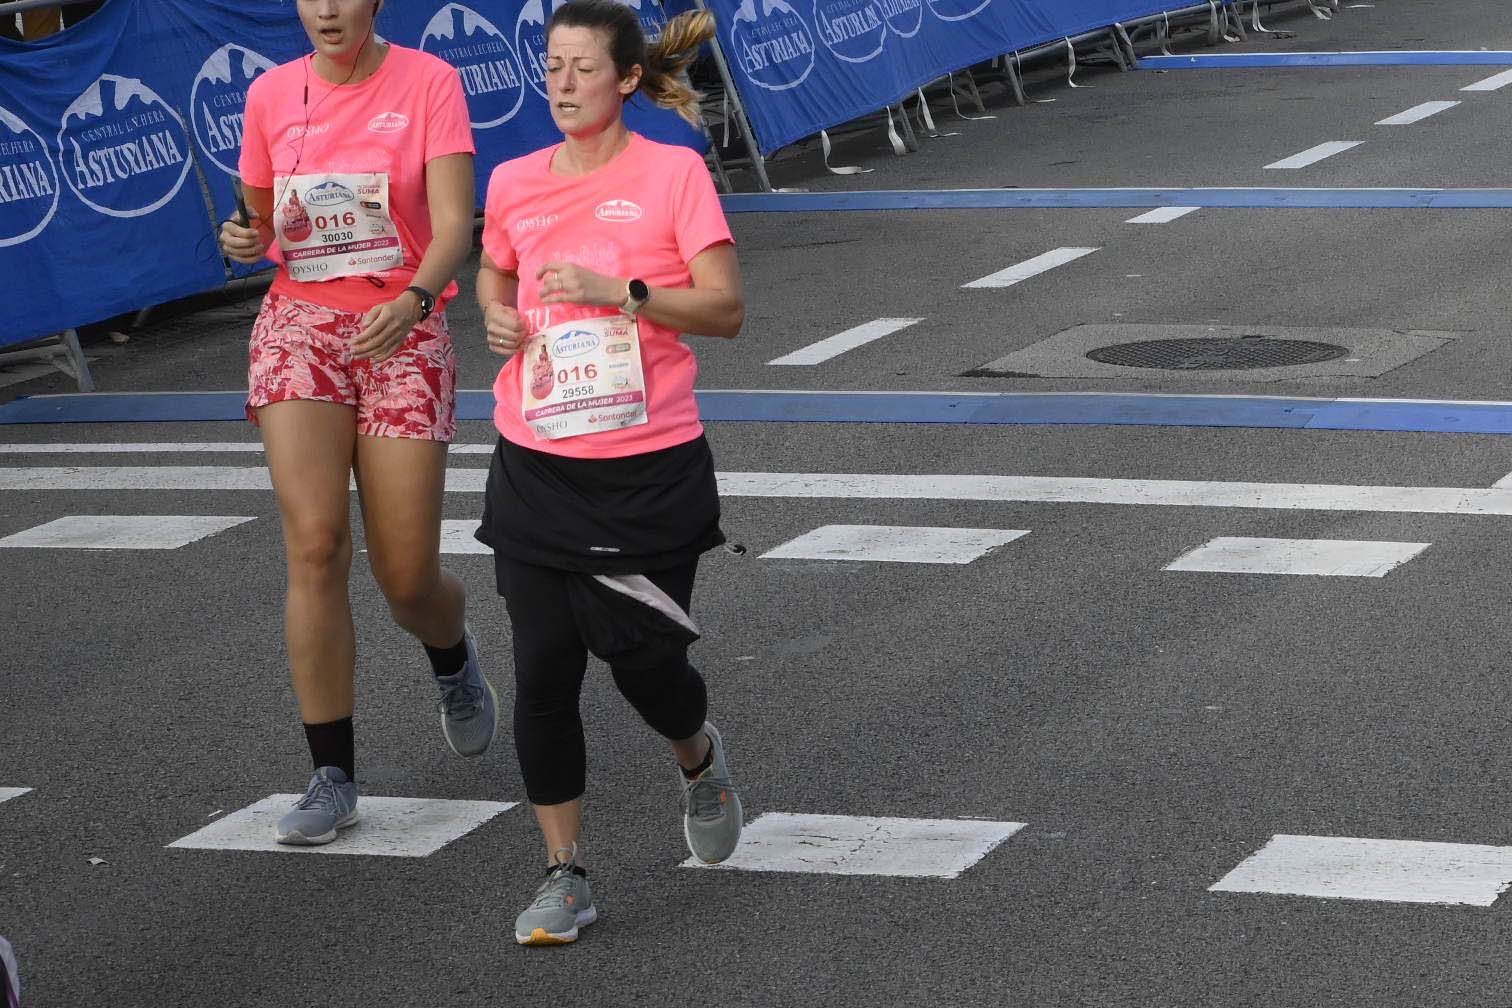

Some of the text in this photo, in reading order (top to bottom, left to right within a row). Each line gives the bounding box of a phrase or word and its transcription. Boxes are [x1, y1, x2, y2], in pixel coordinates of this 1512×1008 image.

[81, 123, 125, 143] CENTRAL
[70, 130, 183, 190] ASTURIANA
[0, 160, 53, 203] RIANA
[315, 212, 356, 230] 016
[321, 231, 353, 243] 30030
[293, 248, 325, 258] CARRERA
[326, 246, 336, 255] DE
[348, 242, 371, 251] MUJER
[374, 239, 389, 247] 2023
[358, 254, 395, 265] Santander
[292, 263, 328, 275] OYSHO
[557, 363, 598, 384] 016
[562, 385, 595, 399] 29558
[535, 395, 633, 417] CARRERA DE LA MUJER 2023
[598, 410, 638, 423] Santander
